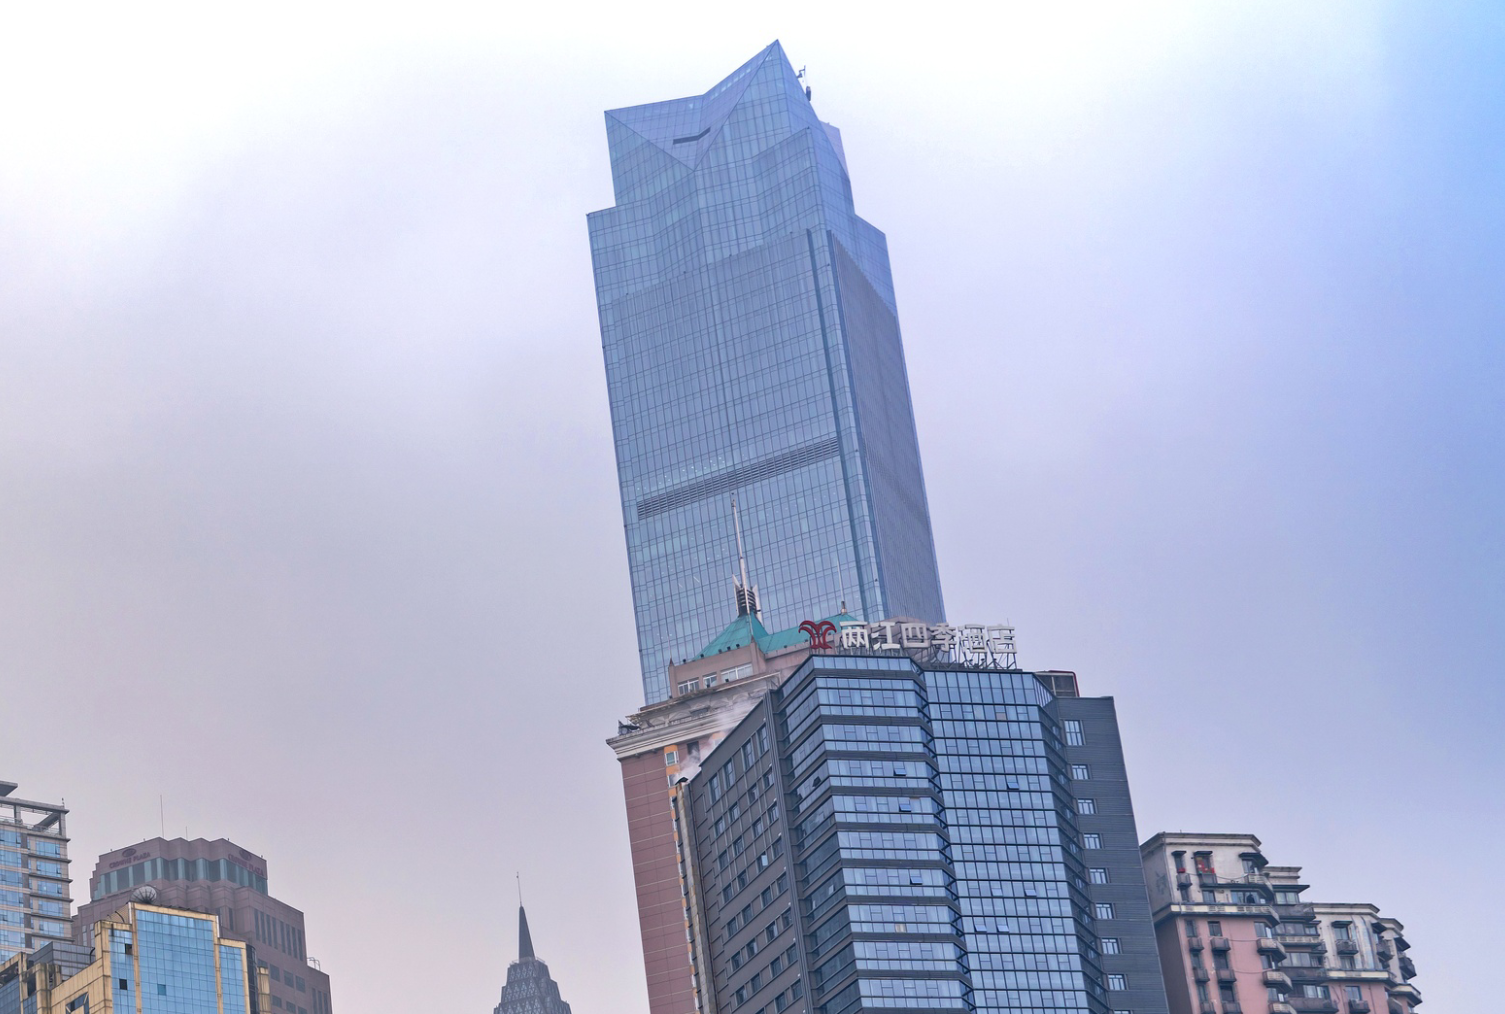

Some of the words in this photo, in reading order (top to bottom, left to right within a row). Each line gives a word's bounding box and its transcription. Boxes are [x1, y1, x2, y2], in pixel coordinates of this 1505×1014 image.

[840, 620, 1018, 654] 两江四季酒店
[133, 851, 151, 863] PLAZA
